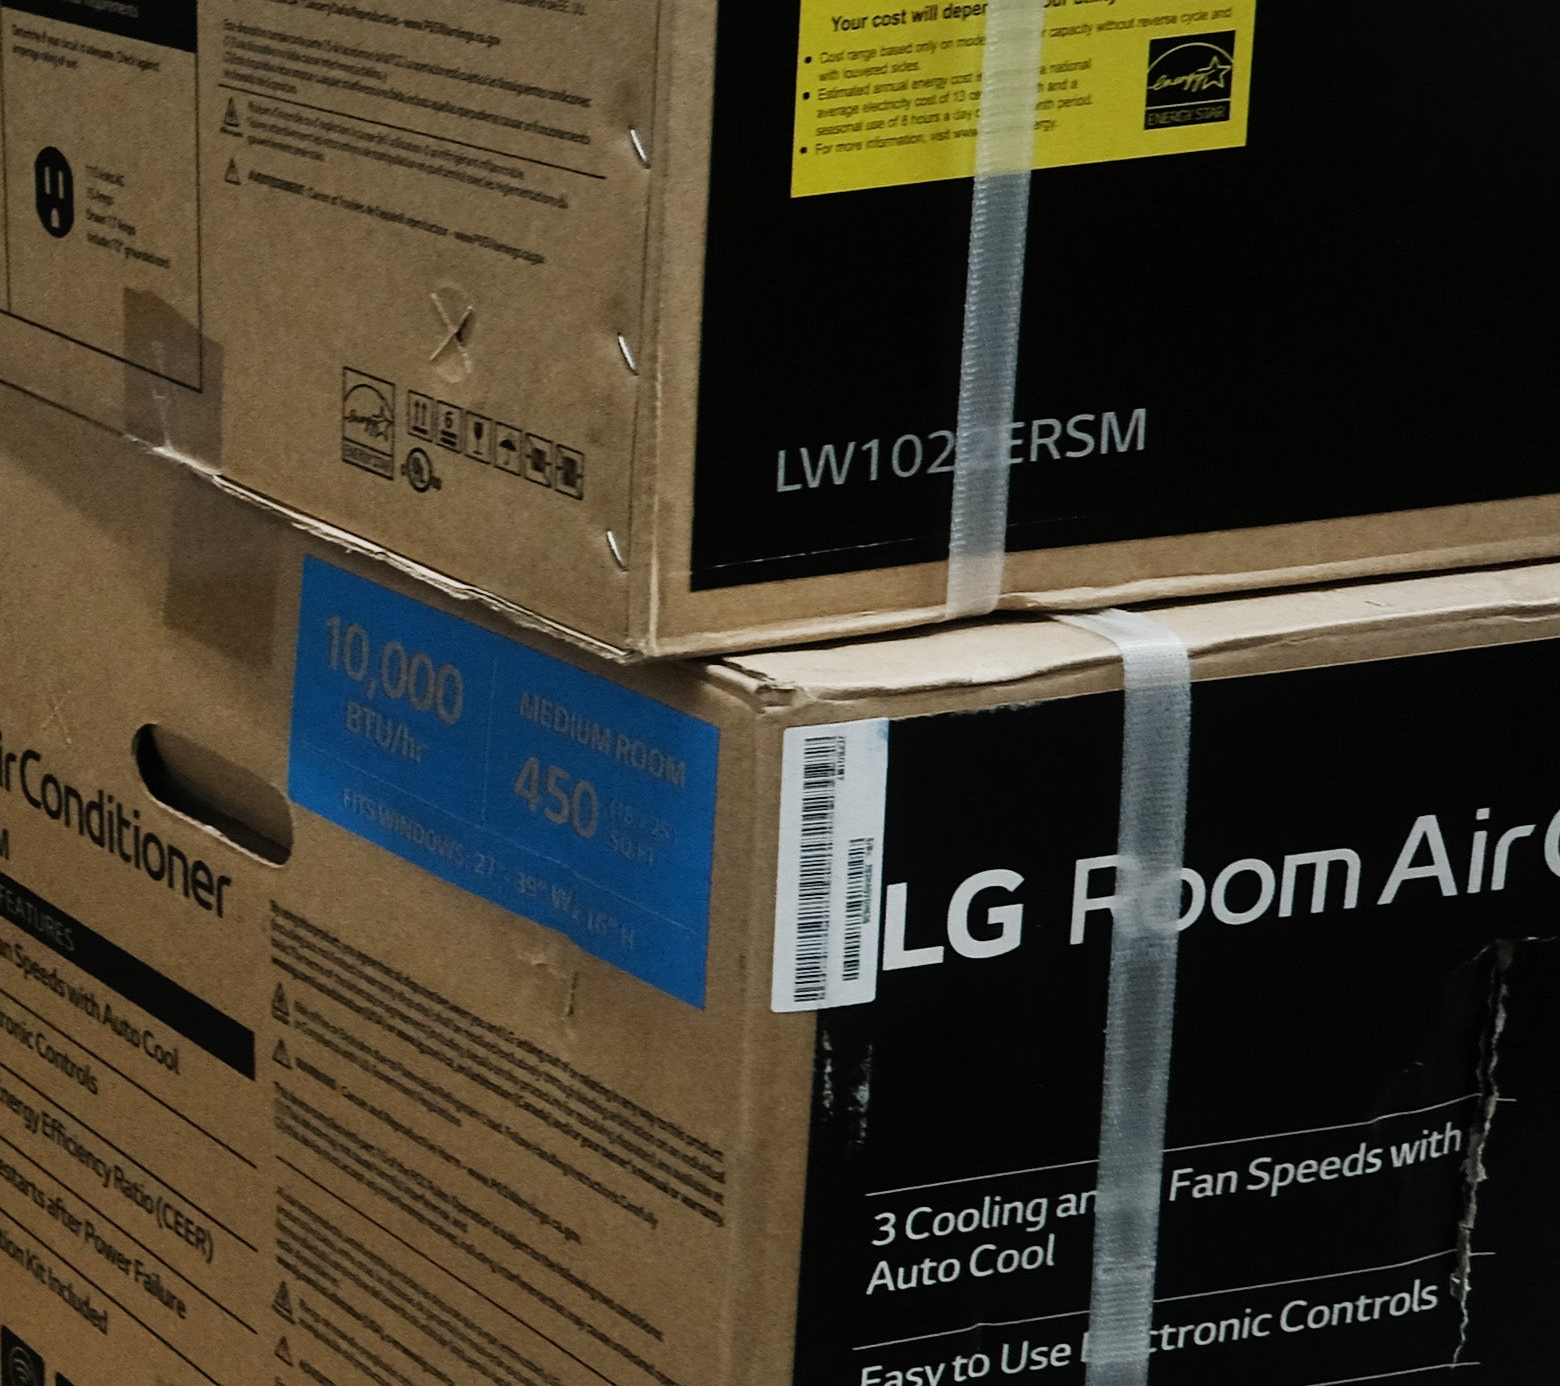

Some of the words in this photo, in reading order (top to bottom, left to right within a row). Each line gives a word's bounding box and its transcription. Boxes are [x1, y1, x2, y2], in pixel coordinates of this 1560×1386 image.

[19, 749, 232, 918] Conditioner
[882, 867, 1024, 971] LG
[1069, 846, 1361, 945] Room
[1377, 807, 1535, 907] Air
[872, 1211, 897, 1247] 3
[904, 1193, 1047, 1243] Cooling
[1168, 1166, 1239, 1202] Fan
[1245, 1143, 1382, 1197] Speeds
[1390, 1122, 1462, 1168] with
